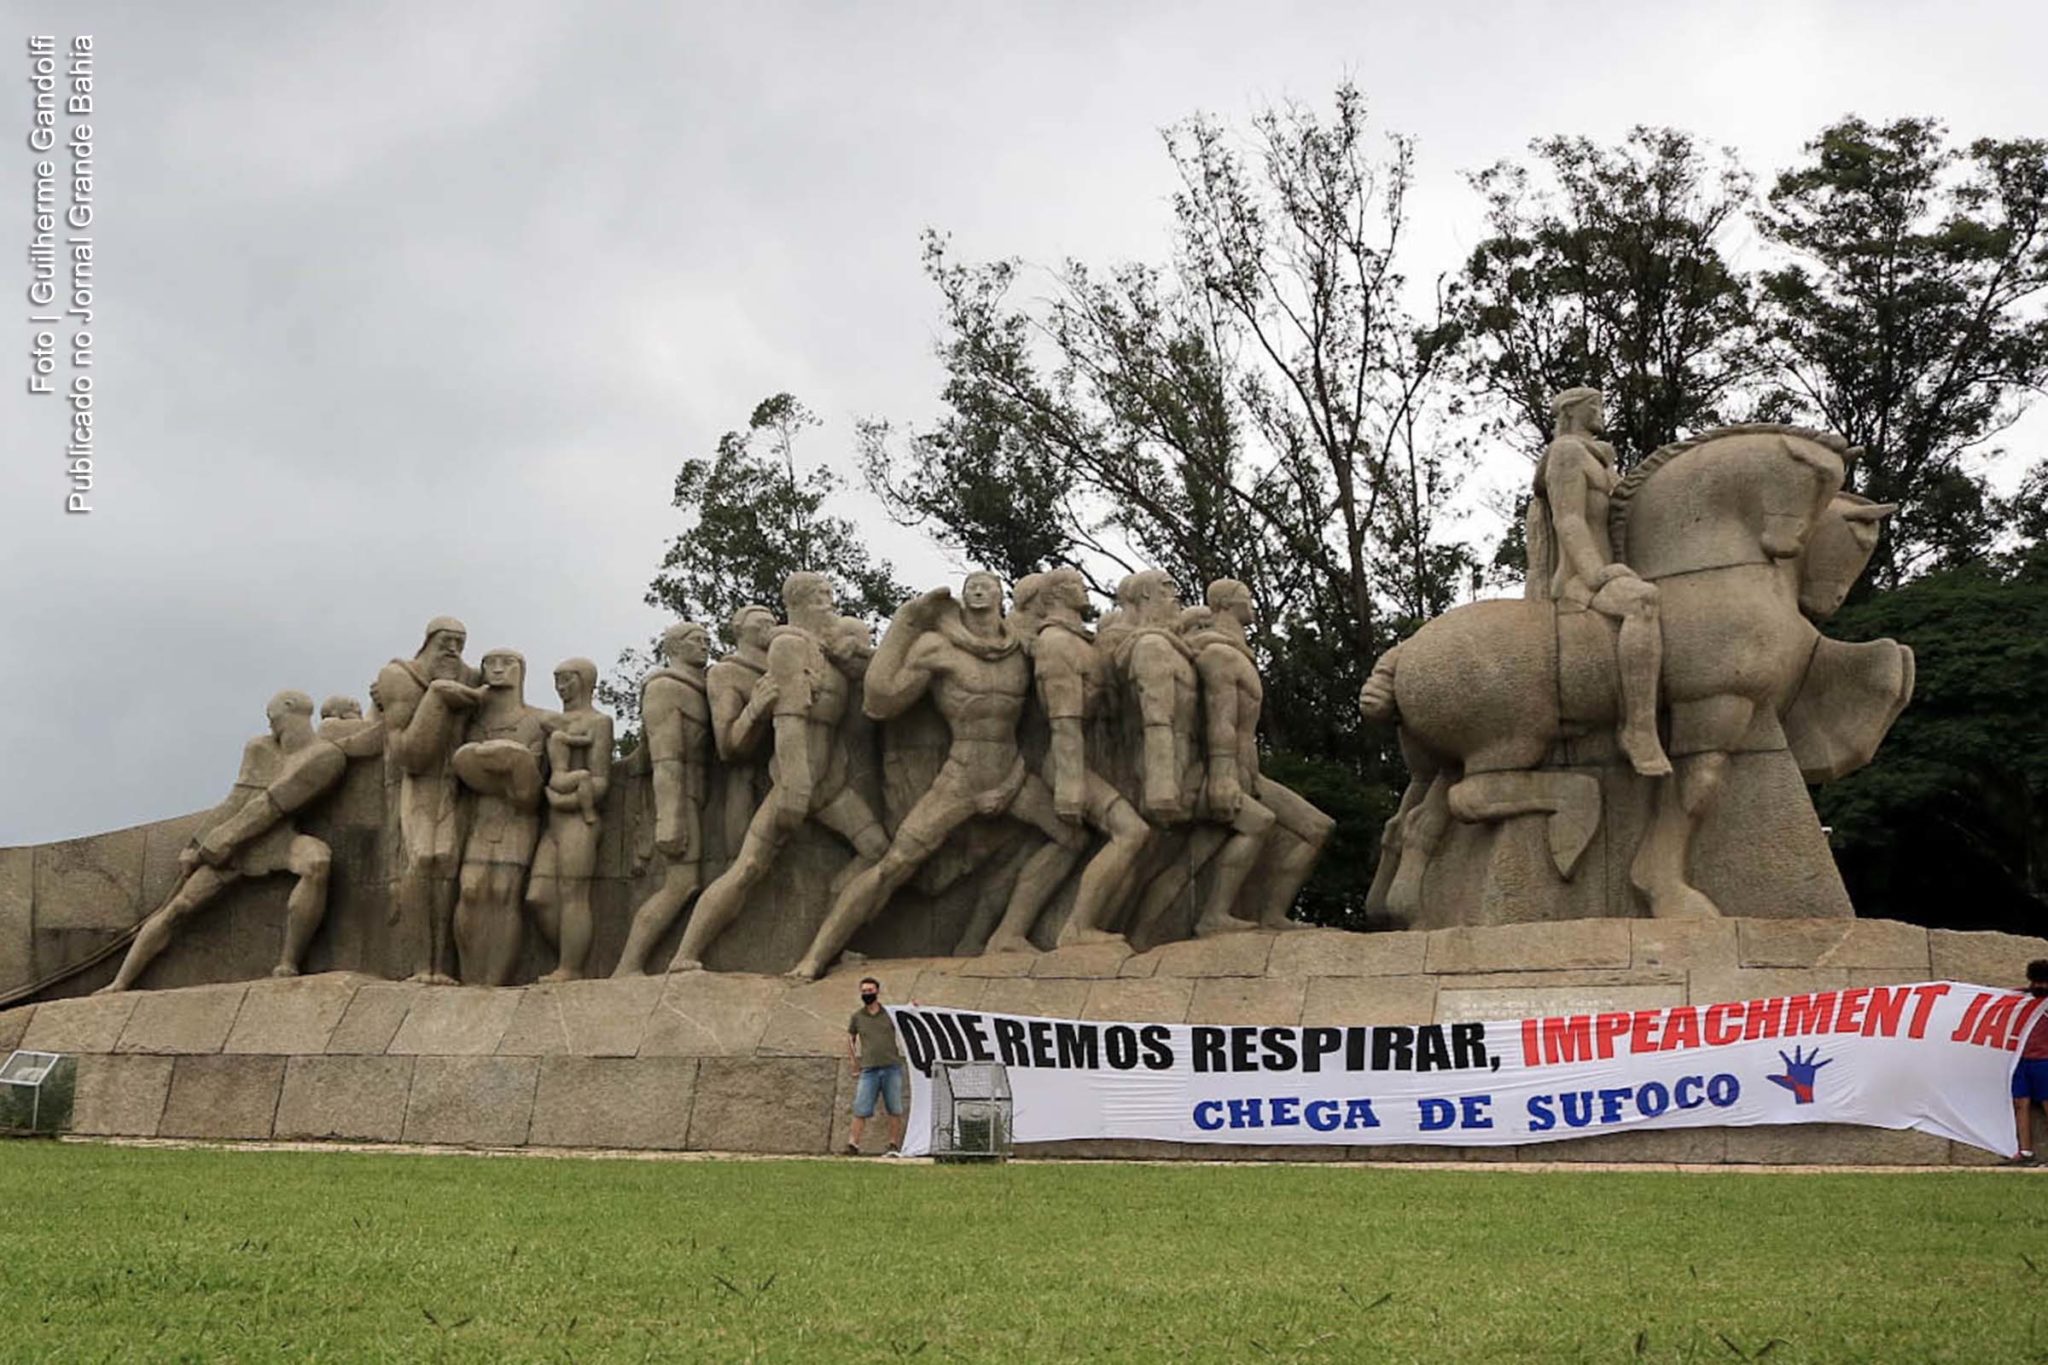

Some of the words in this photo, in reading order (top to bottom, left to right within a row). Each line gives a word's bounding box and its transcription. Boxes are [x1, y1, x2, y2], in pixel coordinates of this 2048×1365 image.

[1192, 1022, 1501, 1073] RESPIRAR,
[1521, 983, 1951, 1067] IMPEACHMENT
[1193, 1098, 1380, 1131] CHEGA
[1419, 1096, 1494, 1130] DE
[1527, 1072, 1741, 1132] SUFOCO
